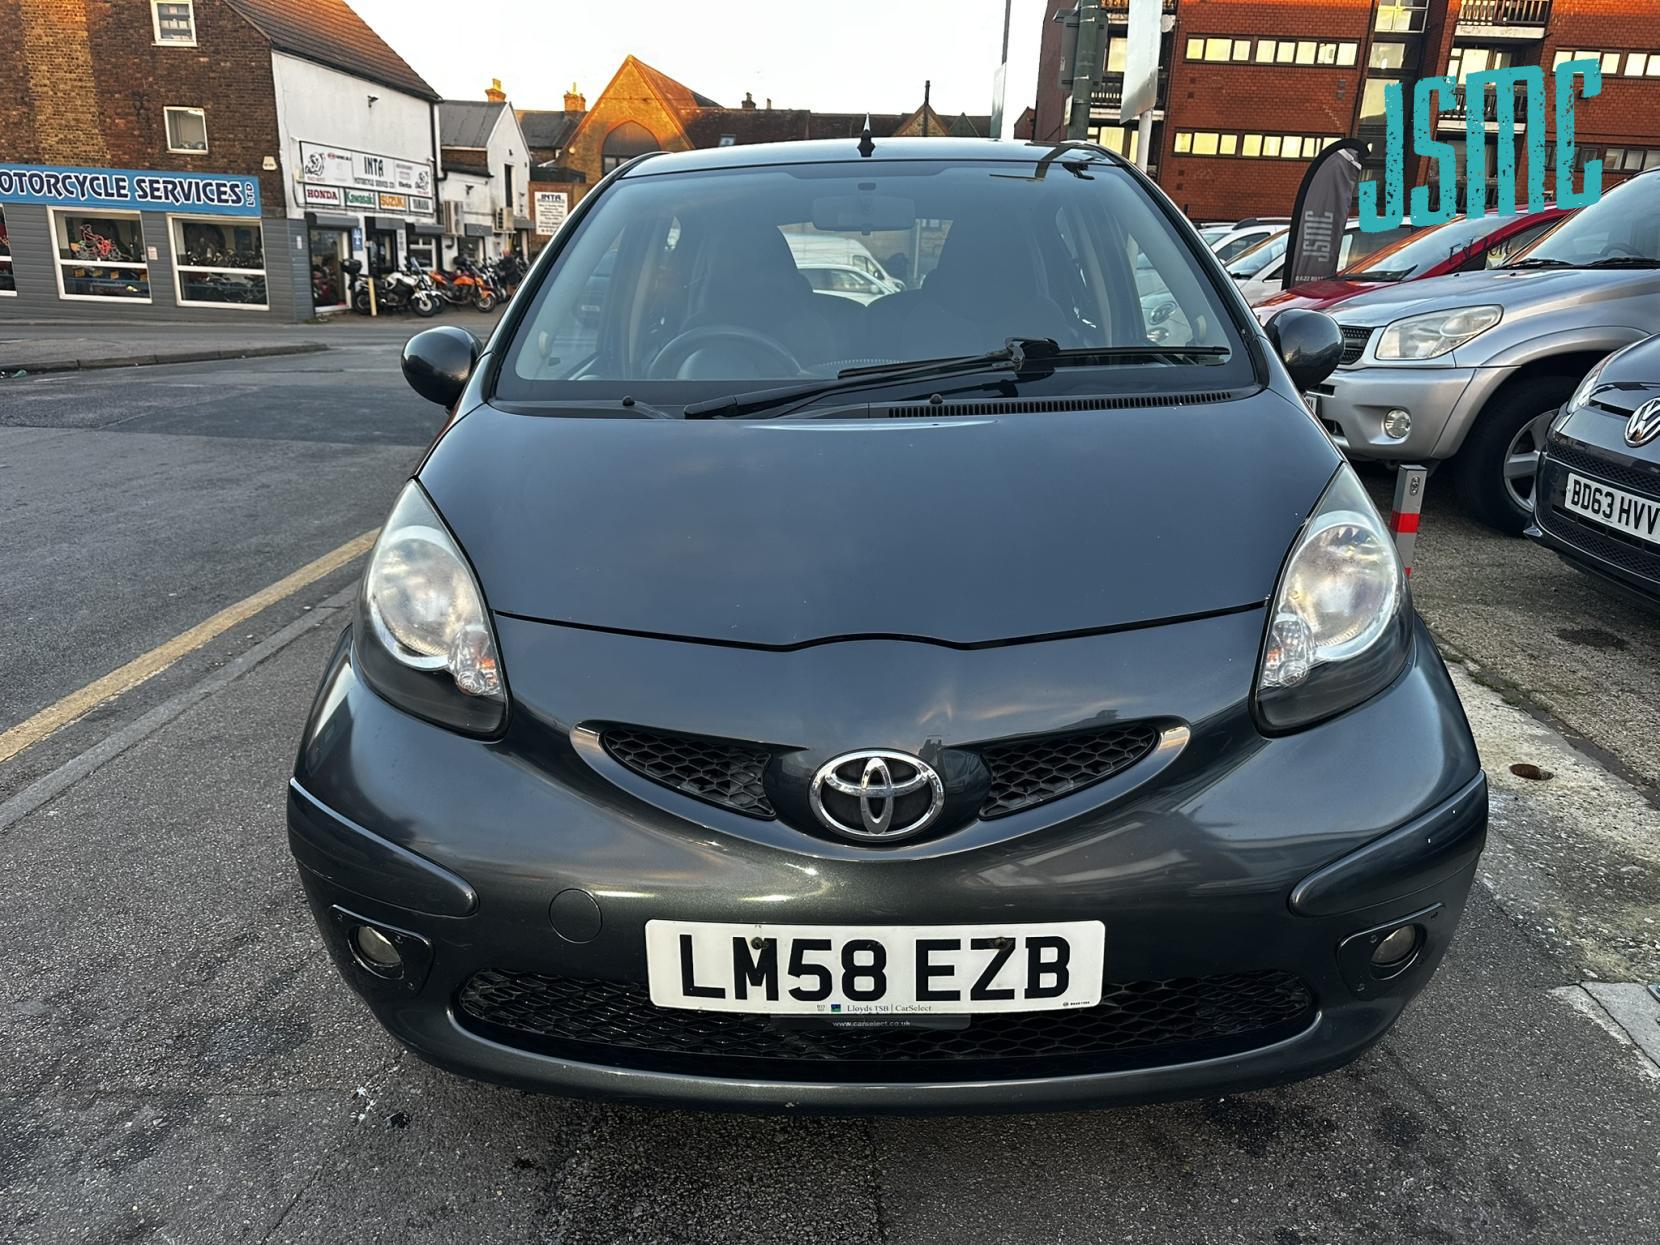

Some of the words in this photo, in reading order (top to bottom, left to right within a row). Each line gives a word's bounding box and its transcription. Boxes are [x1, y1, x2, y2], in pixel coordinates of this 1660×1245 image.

[363, 156, 385, 178] INTA
[0, 170, 130, 200] OTORCYCLE
[134, 176, 243, 205] SERVICES
[245, 181, 256, 207] LTD
[307, 188, 338, 201] HONDA
[345, 191, 376, 205] Kawasaki
[380, 193, 406, 208] SUZUKI
[412, 198, 429, 210] YAMAHA
[1303, 210, 1333, 262] JSMC
[1571, 478, 1615, 519] BD63
[1617, 496, 1660, 535] HVV
[679, 934, 887, 1002] LM58
[915, 936, 1071, 1002] EZB
[847, 1004, 873, 1014] Lloyds
[895, 1004, 932, 1012] CarSelect
